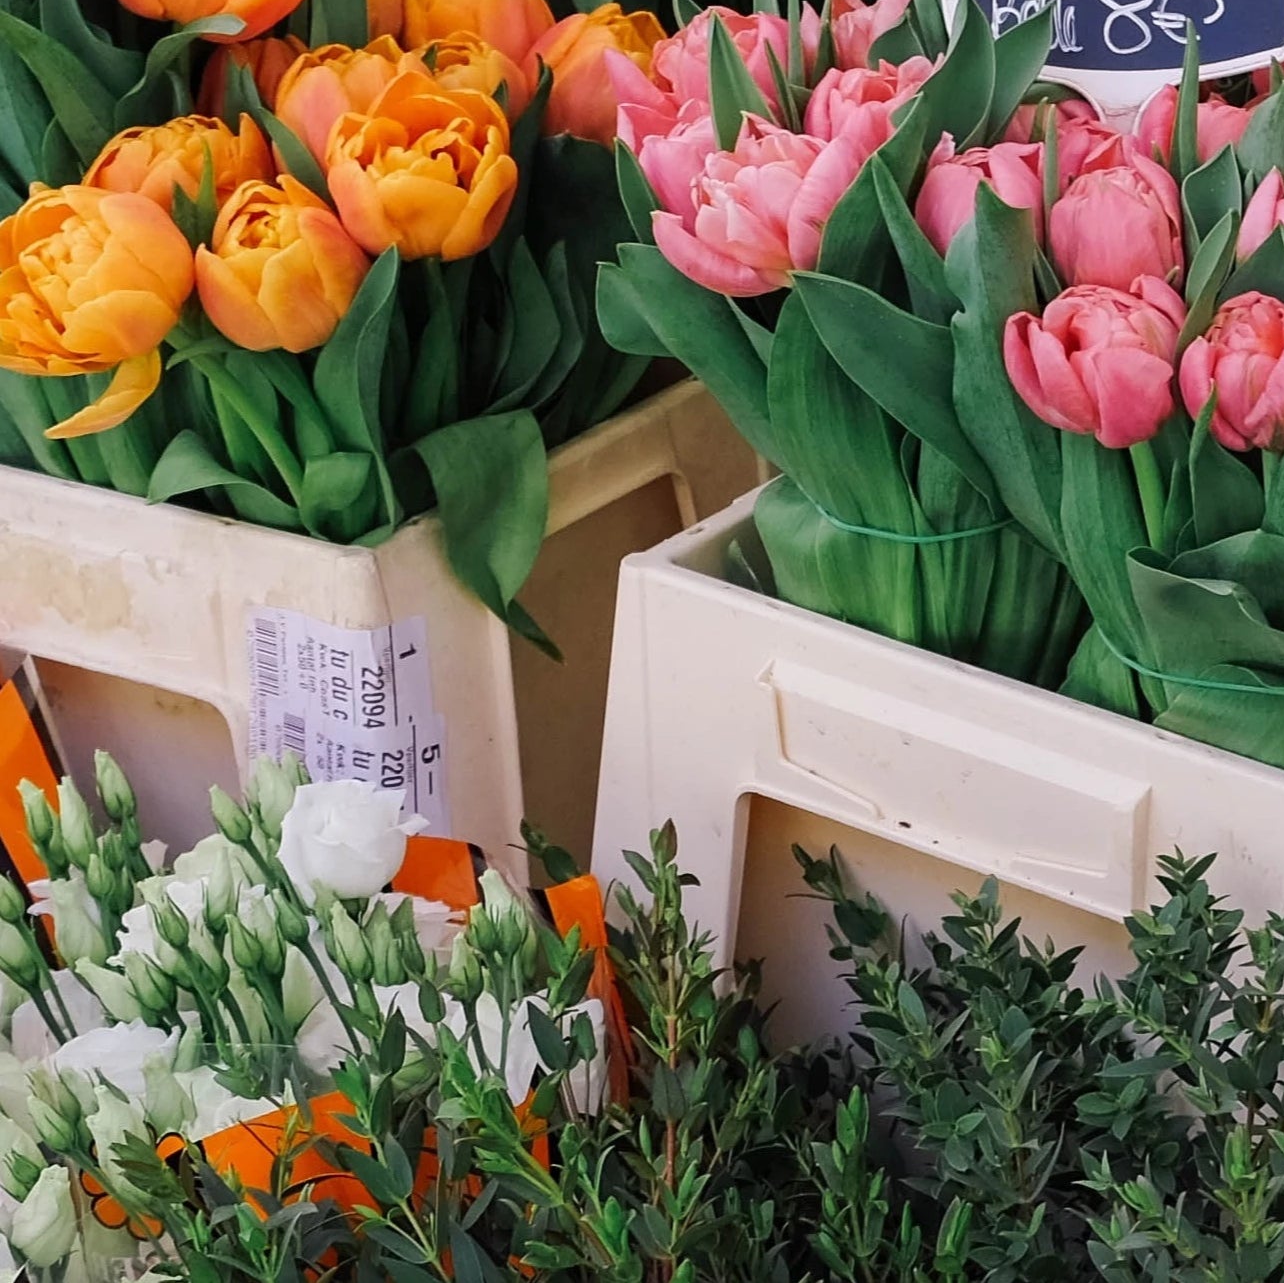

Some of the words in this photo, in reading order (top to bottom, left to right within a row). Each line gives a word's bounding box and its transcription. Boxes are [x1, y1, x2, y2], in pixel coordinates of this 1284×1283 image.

[331, 676, 353, 703] du
[360, 665, 386, 730] 22094
[381, 749, 405, 789] 220
[421, 743, 441, 764] 5
